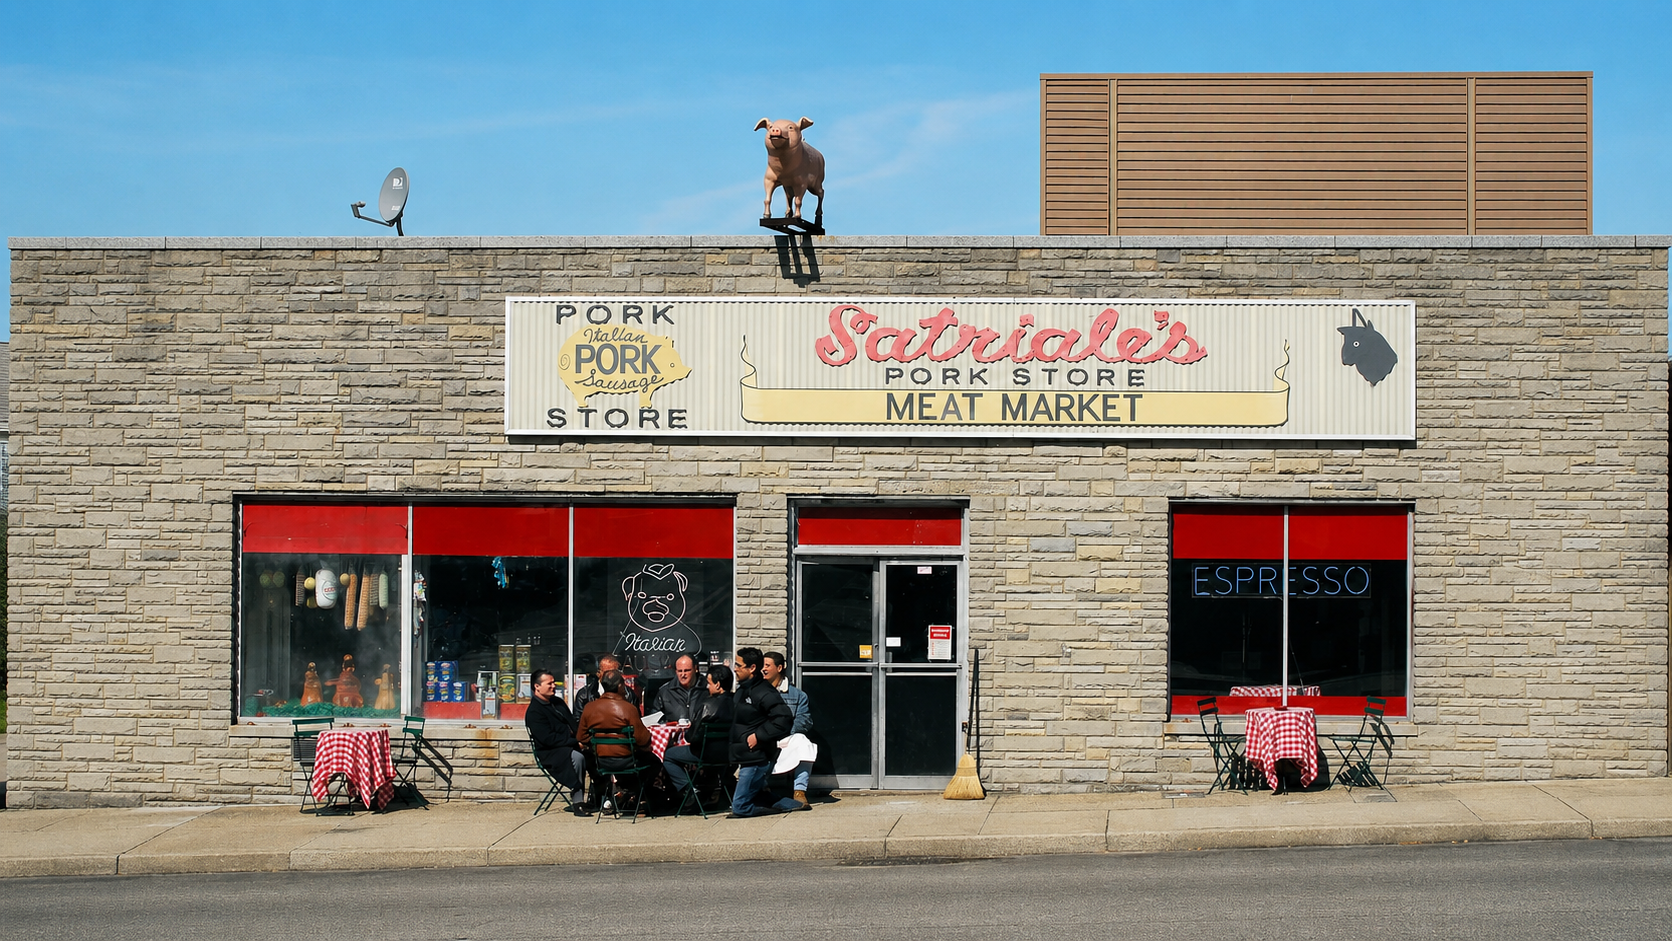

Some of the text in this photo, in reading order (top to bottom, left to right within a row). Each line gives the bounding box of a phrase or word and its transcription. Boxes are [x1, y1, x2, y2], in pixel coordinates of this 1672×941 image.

[556, 304, 675, 325] PORK
[583, 327, 648, 343] Italian
[815, 304, 1208, 367] Satriale's
[575, 343, 662, 375] PORK
[574, 368, 664, 393] Sausage
[885, 367, 1145, 387] PORK STORE
[546, 408, 688, 429] STORE
[886, 392, 1143, 422] MEAT MARKET
[1194, 566, 1370, 596] ESPRESSO
[625, 632, 686, 653] Italian
